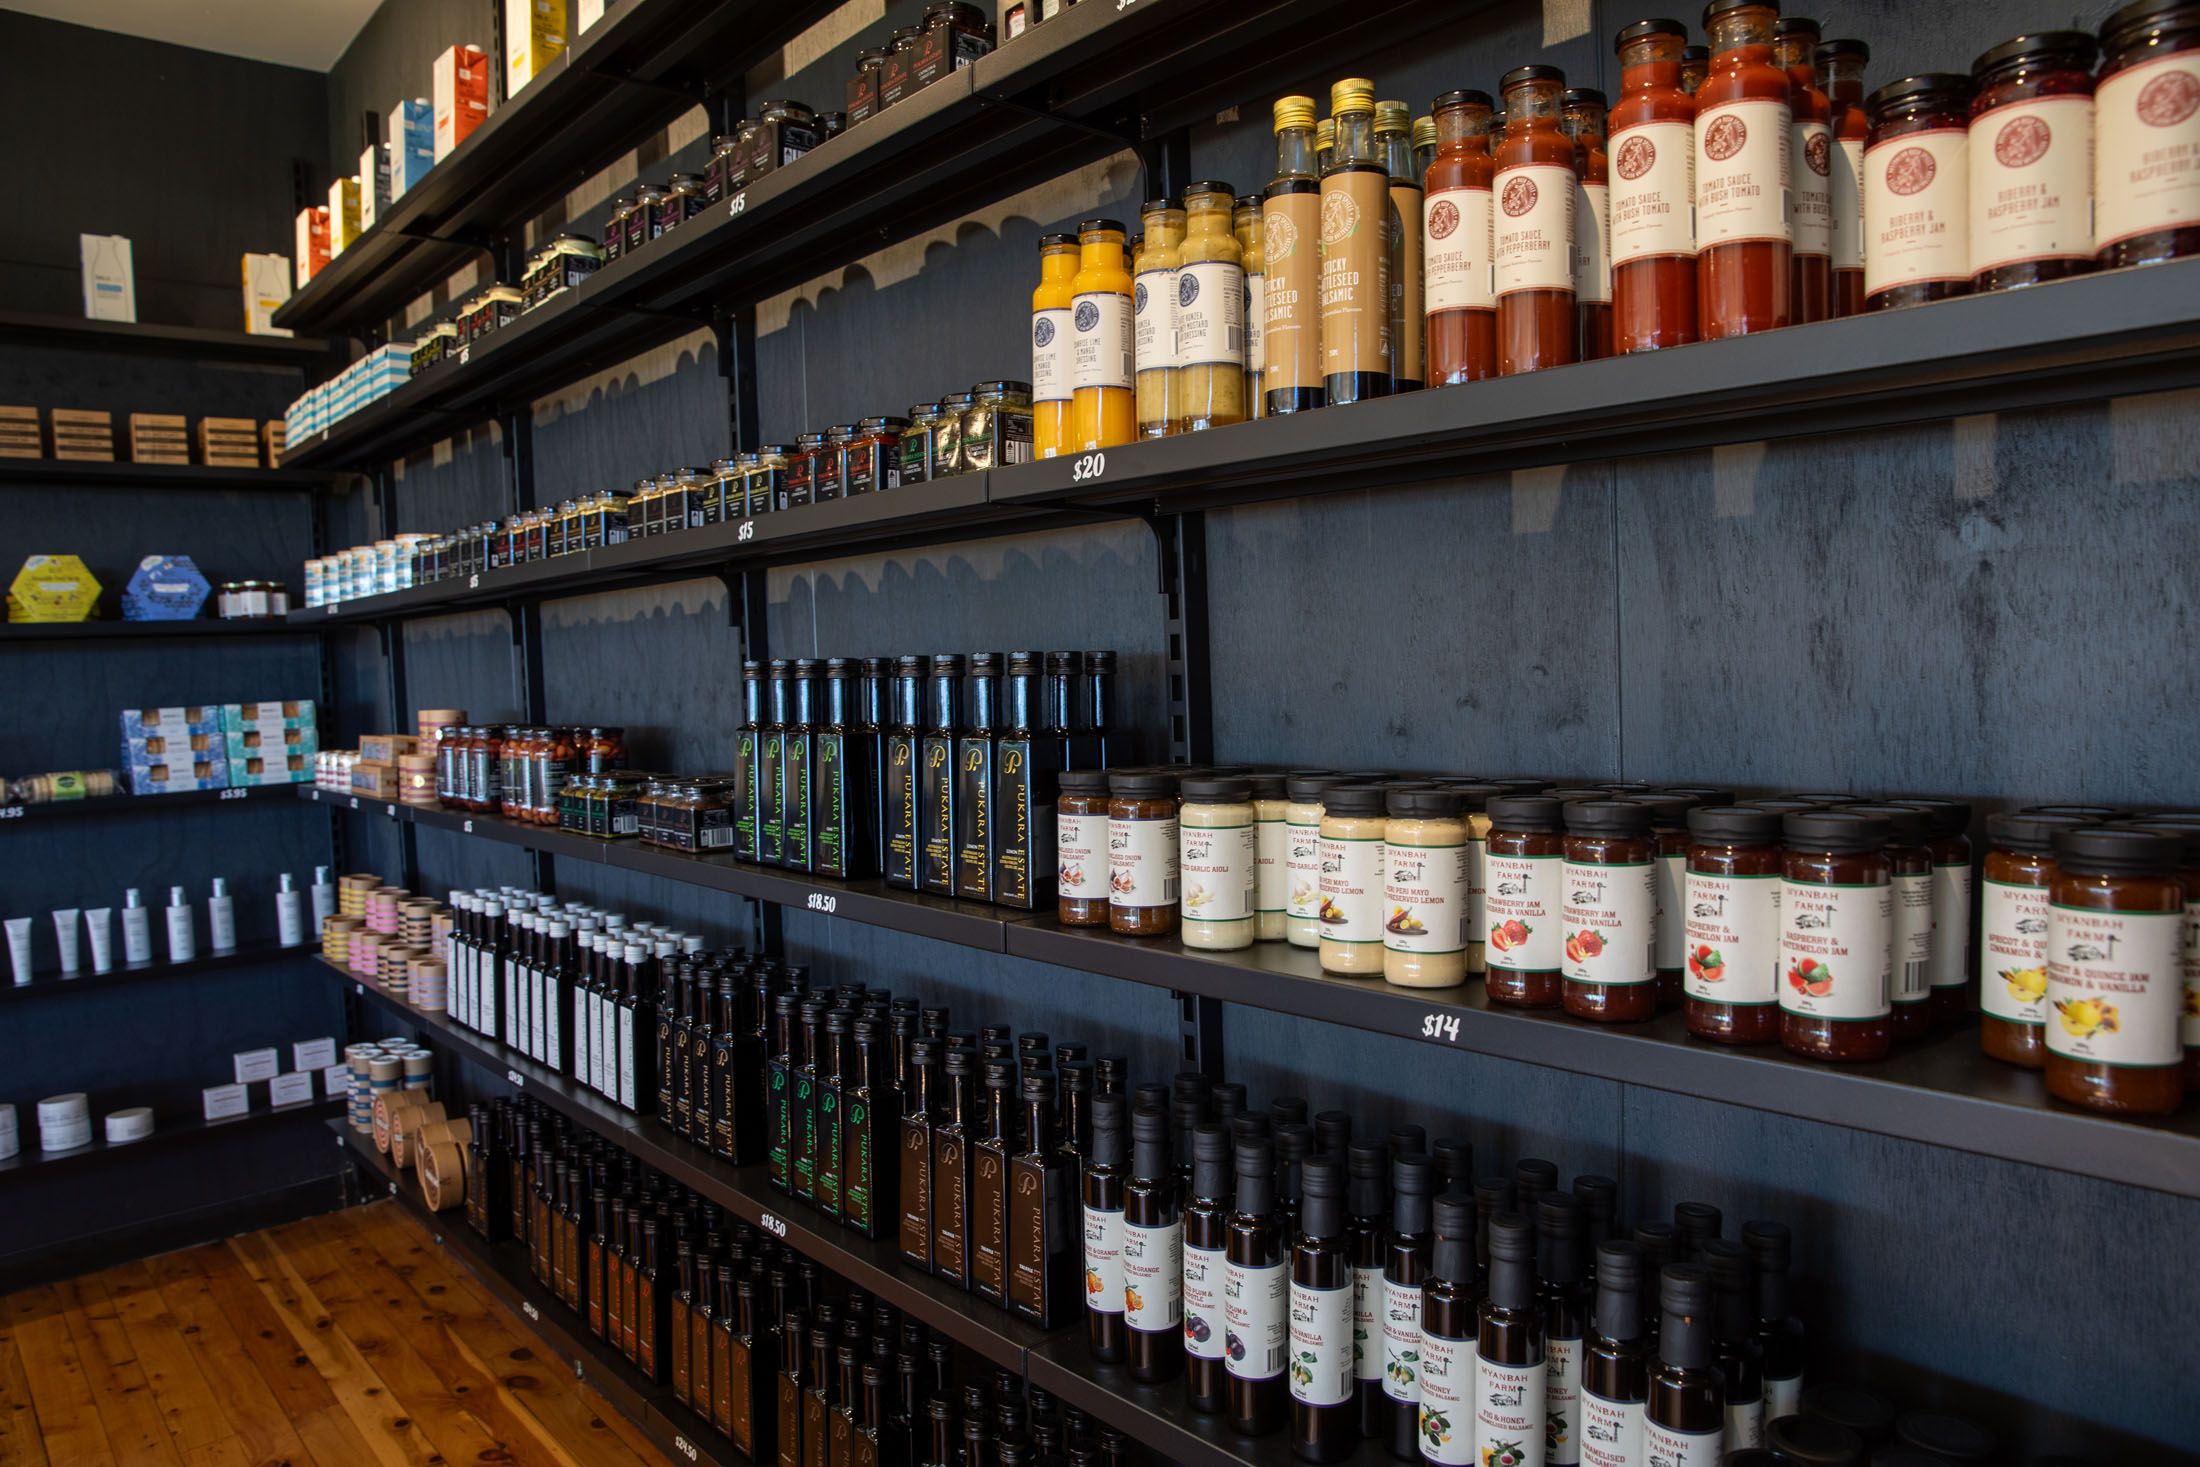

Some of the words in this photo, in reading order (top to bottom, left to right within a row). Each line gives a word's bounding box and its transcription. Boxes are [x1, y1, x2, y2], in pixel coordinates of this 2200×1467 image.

[1702, 177, 1725, 193] TOMATO
[1727, 173, 1752, 186] SAUCE
[1638, 191, 1661, 204] SAUCE
[1710, 189, 1729, 204] BUSH
[1731, 184, 1761, 198] TOMATO
[1621, 207, 1641, 221] BUSH
[1642, 202, 1671, 216] TOMATO
[1988, 199, 2039, 220] RASPBERRY
[2040, 196, 2060, 210] JAM
[1889, 212, 1925, 229] RIBERRY
[1927, 210, 1935, 221] &
[1520, 229, 1542, 241] SAUCE
[1881, 224, 1927, 243] RASPBERRY
[1928, 221, 1946, 235] JAM
[1506, 240, 1551, 256] PEPPERBERRY
[1444, 251, 1463, 263] SAUCE
[1073, 453, 1105, 482] $20
[738, 521, 754, 541] $15
[977, 781, 986, 838] PUKARA
[1292, 837, 1311, 845] FARM
[977, 844, 986, 893] ESTATE
[1190, 865, 1211, 873] GARLIC
[1297, 862, 1318, 870] GARLIC
[1394, 860, 1416, 868] FARM
[1017, 850, 1025, 900] ESTATE
[1497, 872, 1522, 881] FARM
[1333, 879, 1349, 887] MAYO
[1571, 880, 1597, 889] FARM
[1341, 887, 1364, 895] LEMON
[1396, 887, 1409, 895] PERI
[1410, 888, 1430, 896] MAYO
[1693, 892, 1717, 902] FARM
[807, 893, 836, 913] $18.50
[1420, 896, 1445, 904] LEMON
[1795, 901, 1824, 912] FARM
[1515, 909, 1546, 917] VANILLA
[1589, 919, 1622, 927] VANILLA
[1724, 935, 1739, 943] JAM
[1786, 932, 1827, 945] RASPBERRY
[2067, 929, 2105, 942] FARM
[1831, 948, 1848, 956] JAM
[2034, 951, 2042, 959] &
[2073, 968, 2081, 976] &
[2084, 969, 2126, 981] QUINCE
[2129, 973, 2151, 983] JAM
[2085, 981, 2094, 989] &
[2099, 982, 2147, 994] VANILLA
[1422, 1014, 1461, 1042] $14
[953, 1176, 961, 1229] PUKARA
[992, 1190, 1000, 1244] PUKARA
[761, 1213, 787, 1238] $18.50
[1032, 1207, 1041, 1262] PUKARA
[954, 1234, 962, 1281] ESTATE
[993, 1250, 1001, 1298] ESTATE
[1033, 1268, 1041, 1318] ESTATE
[1389, 1300, 1411, 1310] FARM
[1298, 1328, 1322, 1341] VANILLA
[1482, 1366, 1528, 1382] MYANBAH
[1430, 1383, 1451, 1394] HONEY
[1489, 1381, 1517, 1393] FARM
[1483, 1409, 1493, 1419] FIG
[1499, 1414, 1526, 1424] HONEY
[1587, 1412, 1612, 1428] FARM
[1509, 1423, 1534, 1431] BALSAMIC
[1581, 1440, 1625, 1463] CARAMELISED
[1649, 1440, 1675, 1459] FARM
